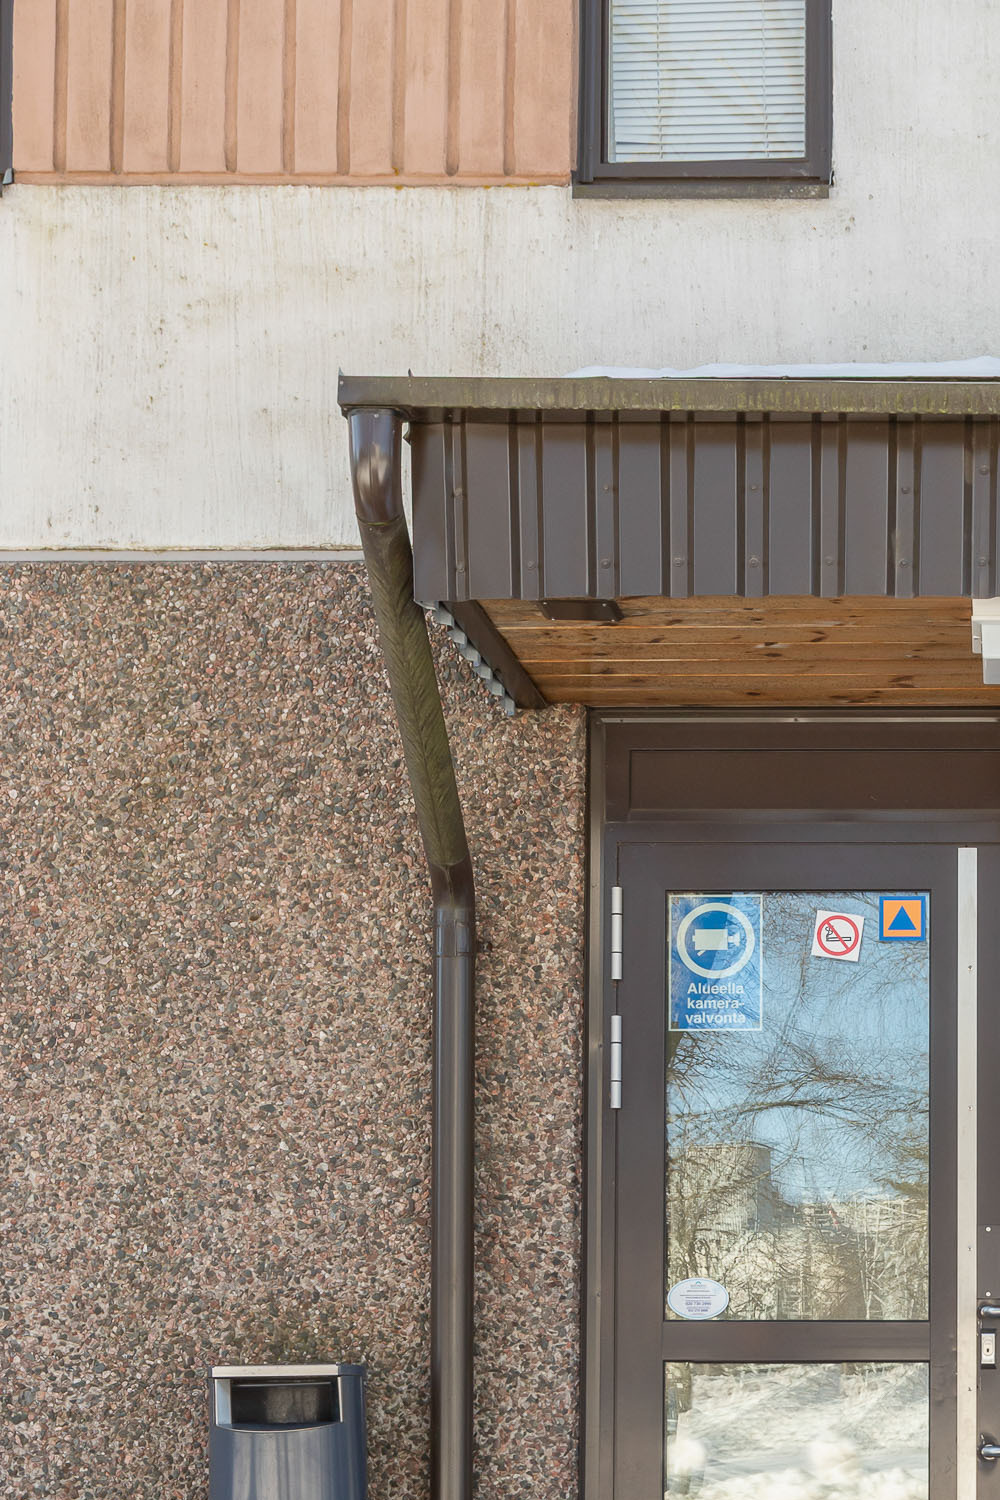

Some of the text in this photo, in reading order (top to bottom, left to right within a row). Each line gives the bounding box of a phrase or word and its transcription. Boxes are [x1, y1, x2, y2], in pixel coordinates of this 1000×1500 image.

[687, 982, 745, 995] Alueella
[687, 997, 745, 1009] kamera-
[685, 1011, 746, 1024] valvonta
